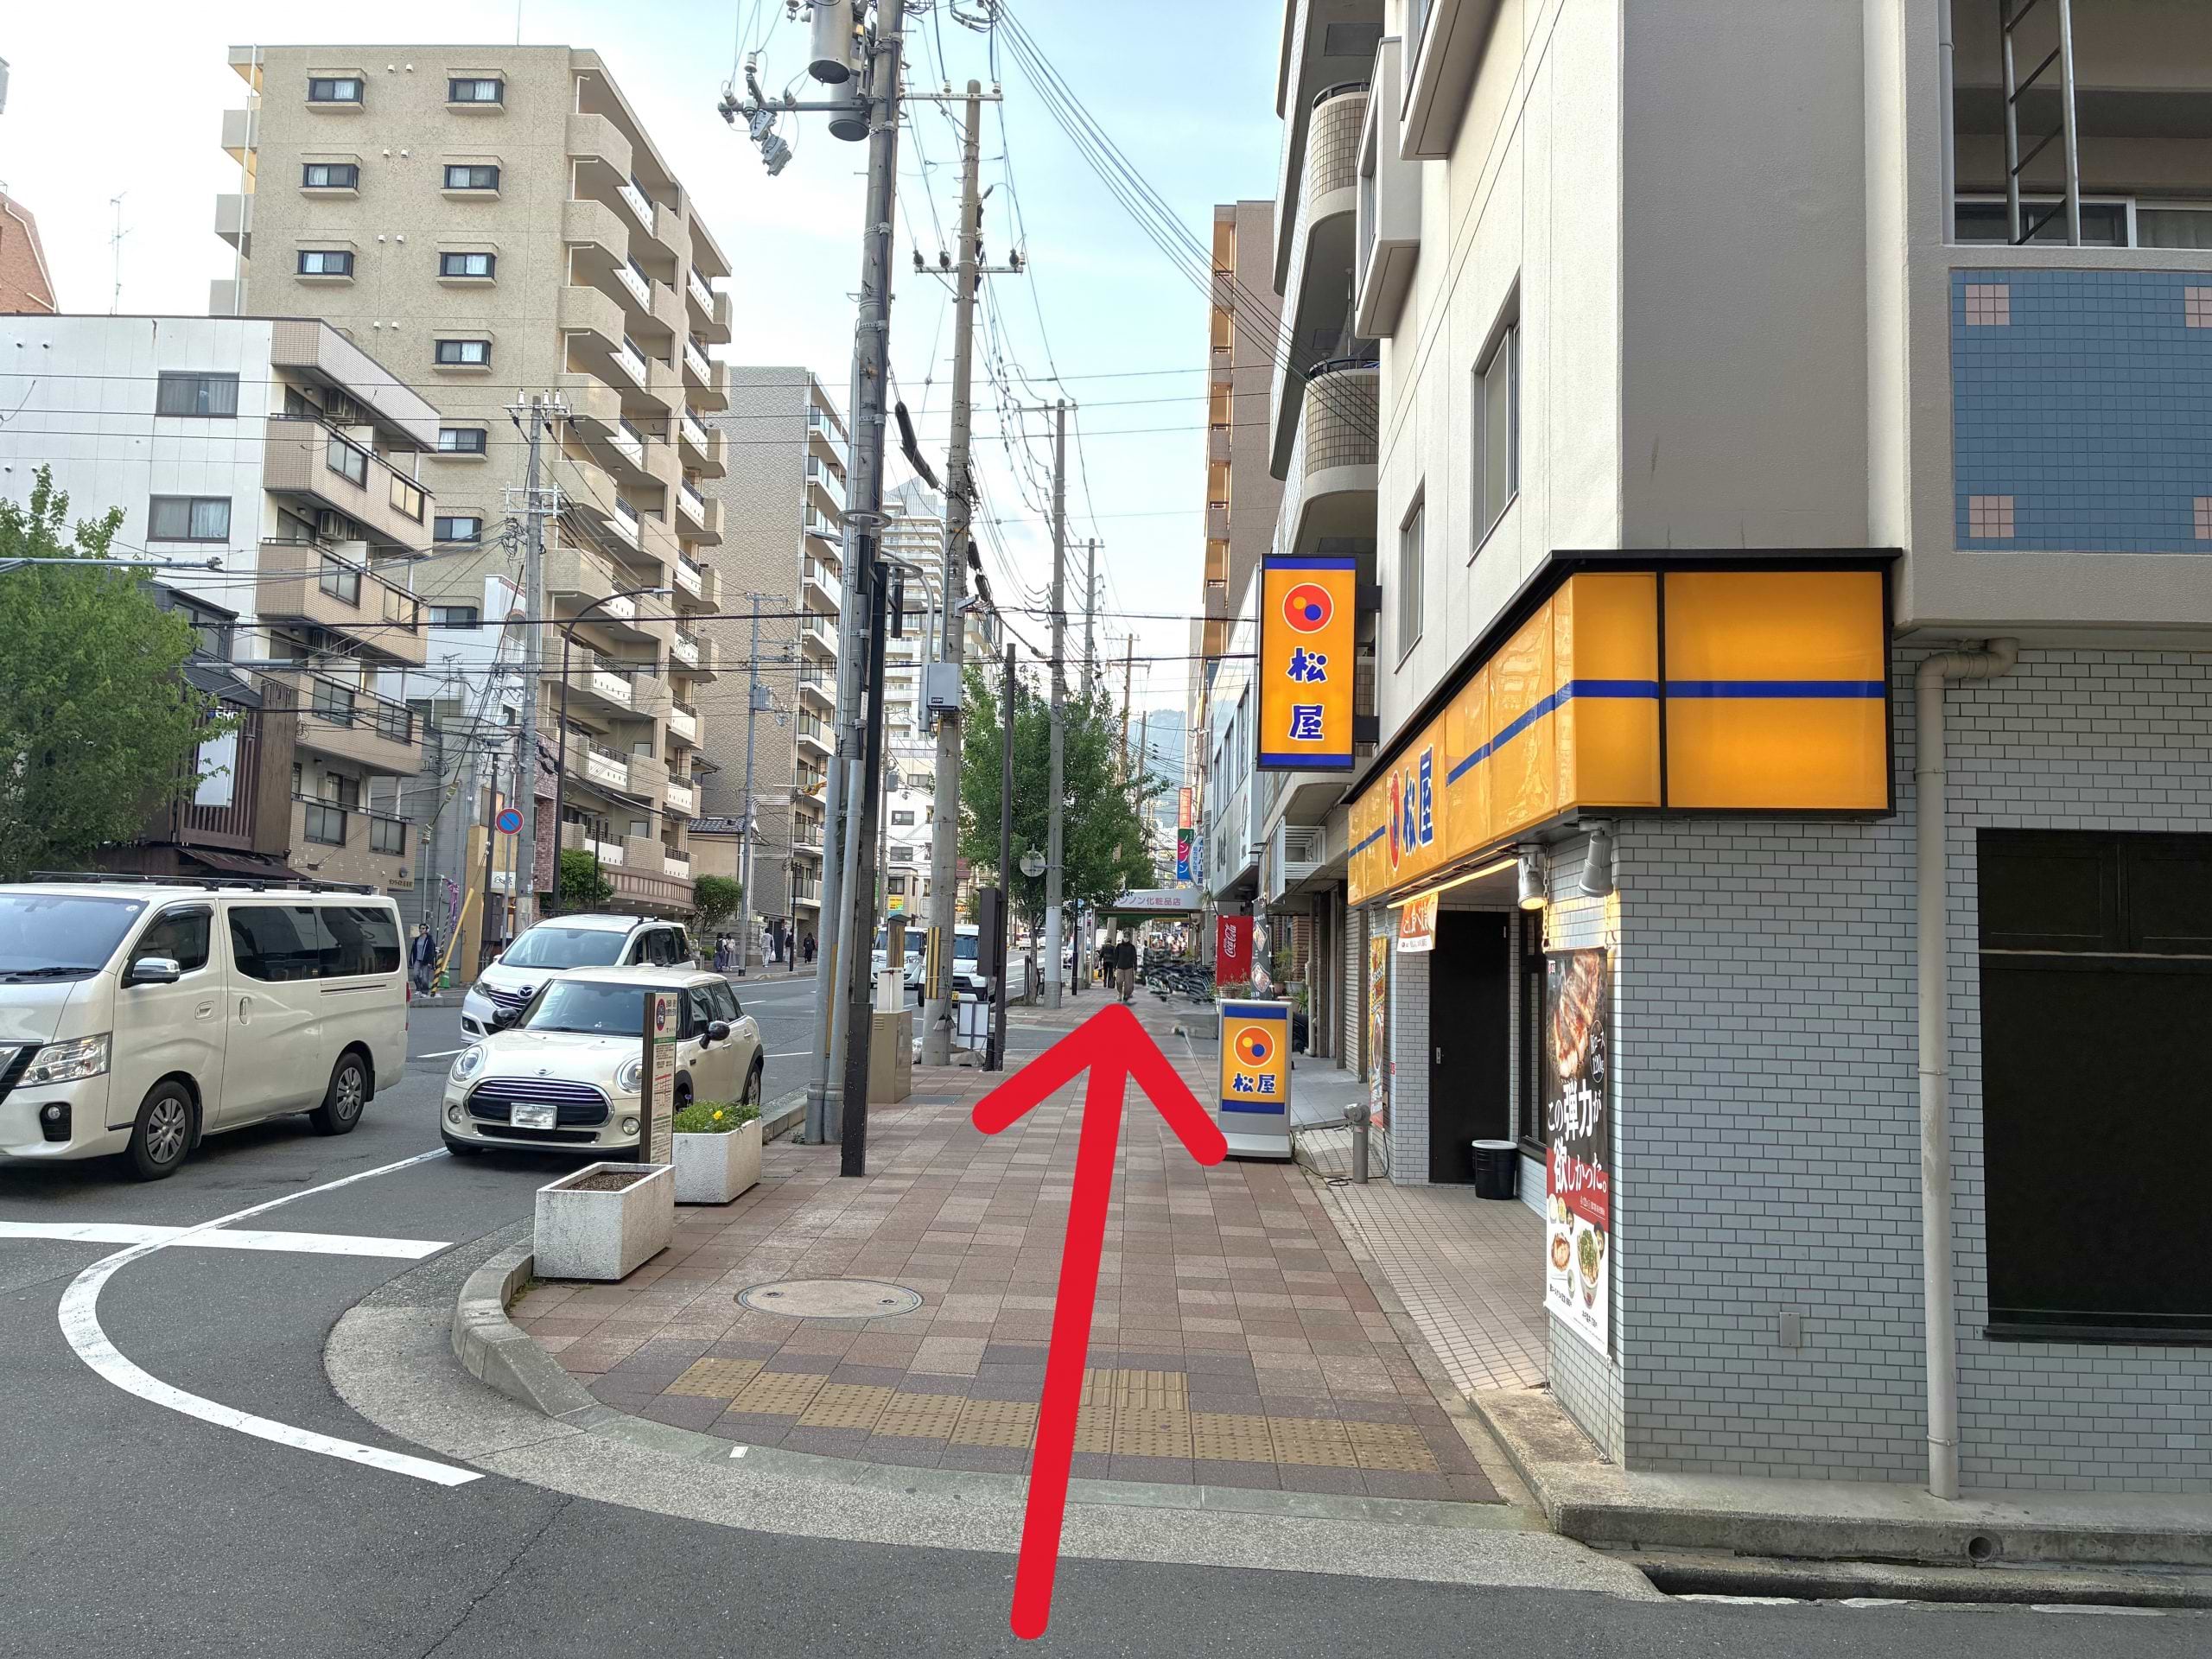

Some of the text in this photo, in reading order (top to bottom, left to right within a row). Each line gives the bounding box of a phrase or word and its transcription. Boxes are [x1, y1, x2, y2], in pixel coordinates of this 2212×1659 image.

[1287, 647, 1328, 740] 松屋
[1402, 747, 1434, 856] 松屋
[1120, 897, 1181, 906] ンノン化粧品店
[1232, 1072, 1275, 1094] 松屋
[1548, 1078, 1602, 1141] この弾力が
[1554, 1136, 1607, 1193] 欲しかった。
